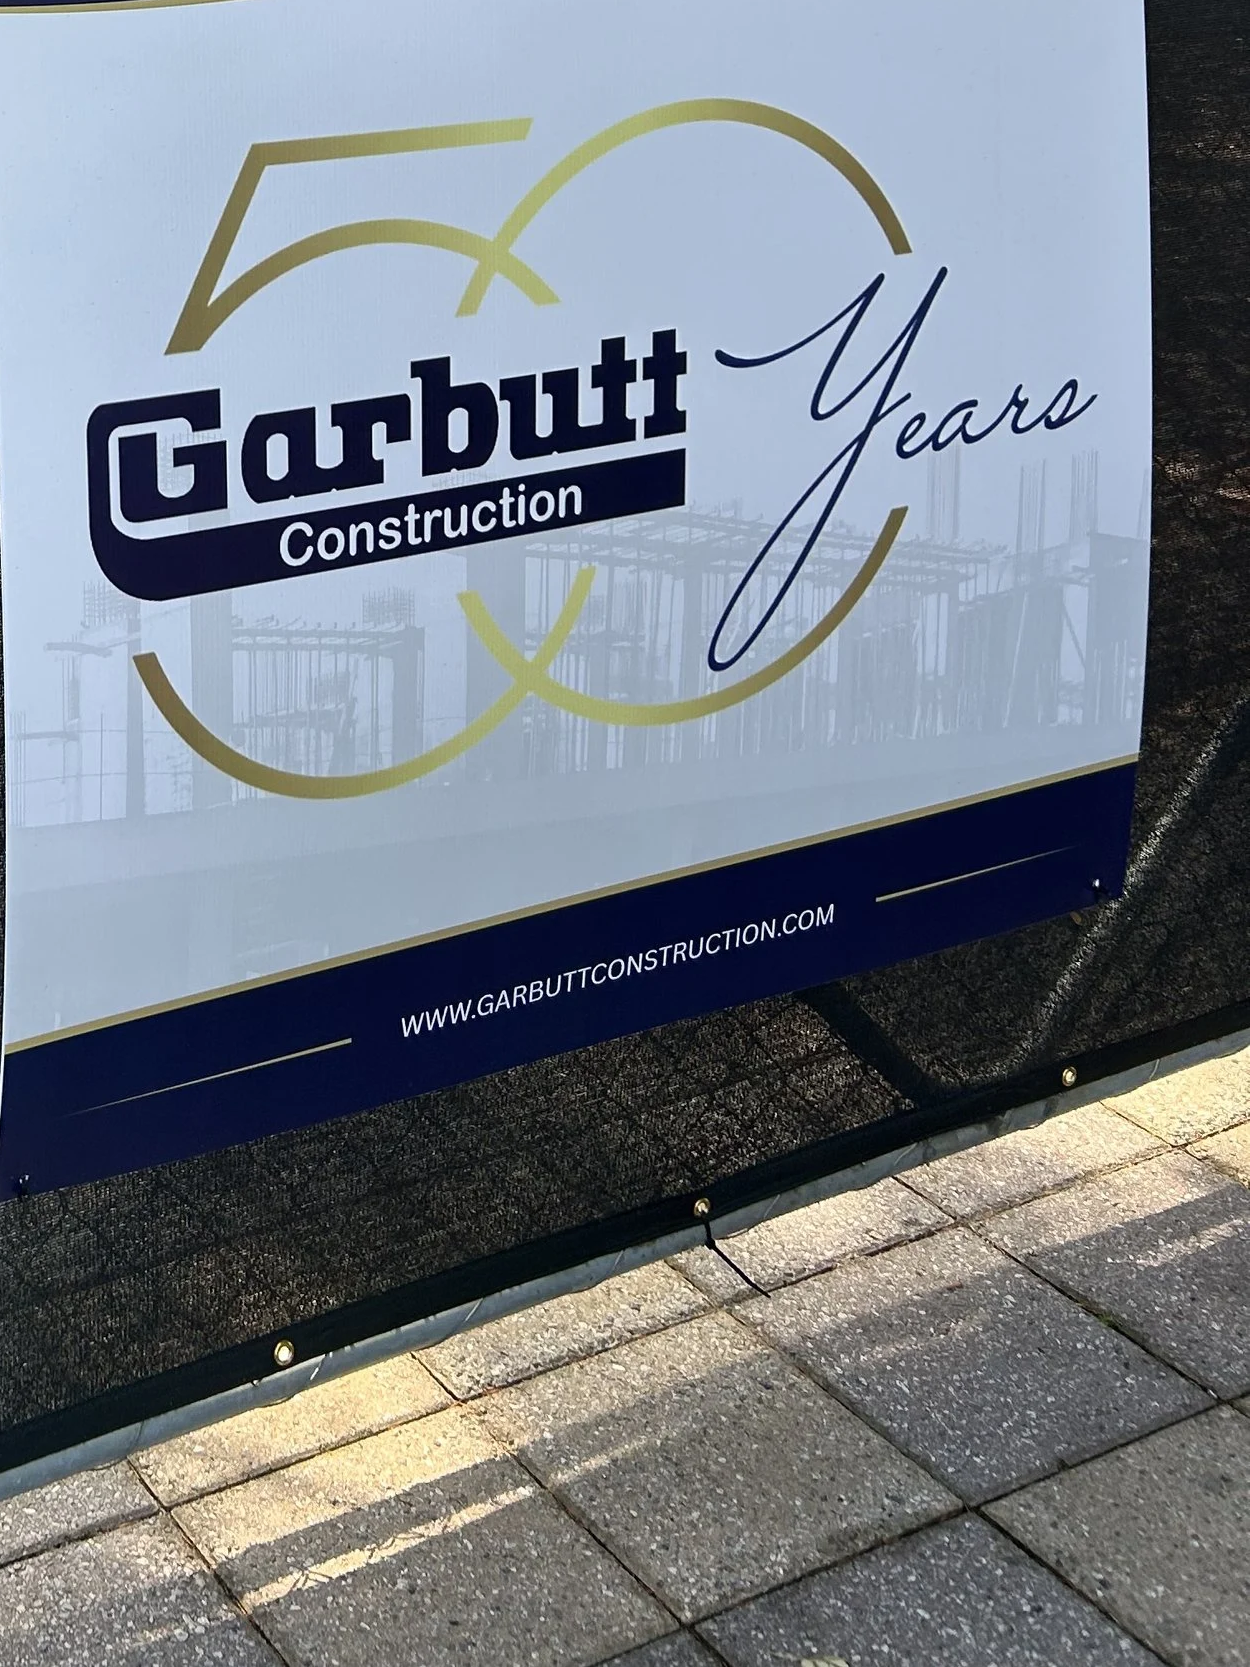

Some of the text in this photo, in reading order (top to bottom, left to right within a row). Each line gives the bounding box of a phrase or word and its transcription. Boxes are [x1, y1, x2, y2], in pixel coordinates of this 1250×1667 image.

[116, 266, 1097, 672] Garbutt Years
[279, 478, 584, 568] Construction
[400, 902, 836, 1039] WWW.GARBUTTCONSTRUCTION.COM
